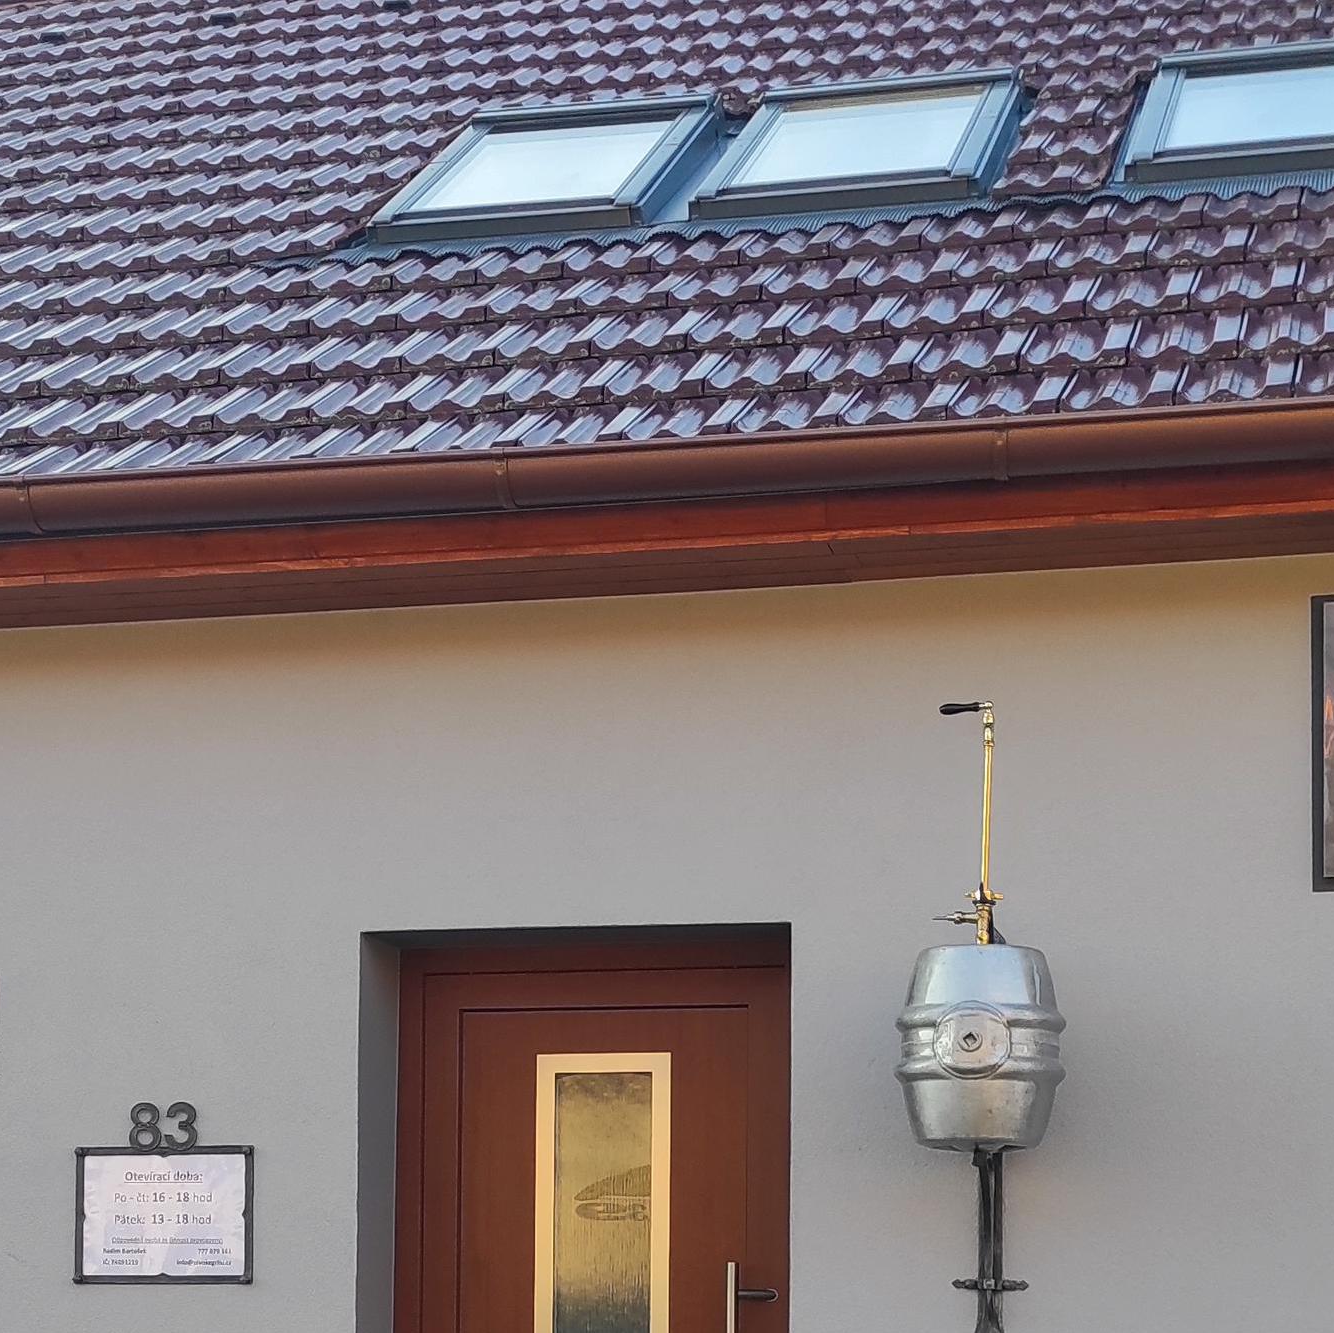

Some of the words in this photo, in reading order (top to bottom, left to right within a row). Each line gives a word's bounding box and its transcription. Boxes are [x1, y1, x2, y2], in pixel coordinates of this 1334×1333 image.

[128, 1101, 198, 1151] 83
[173, 1171, 204, 1182] doba:
[114, 1192, 127, 1203] Po
[152, 1192, 166, 1203] 16
[176, 1192, 190, 1203] 18
[192, 1192, 213, 1203] hod
[176, 1214, 189, 1225] 18
[192, 1214, 212, 1225] hod
